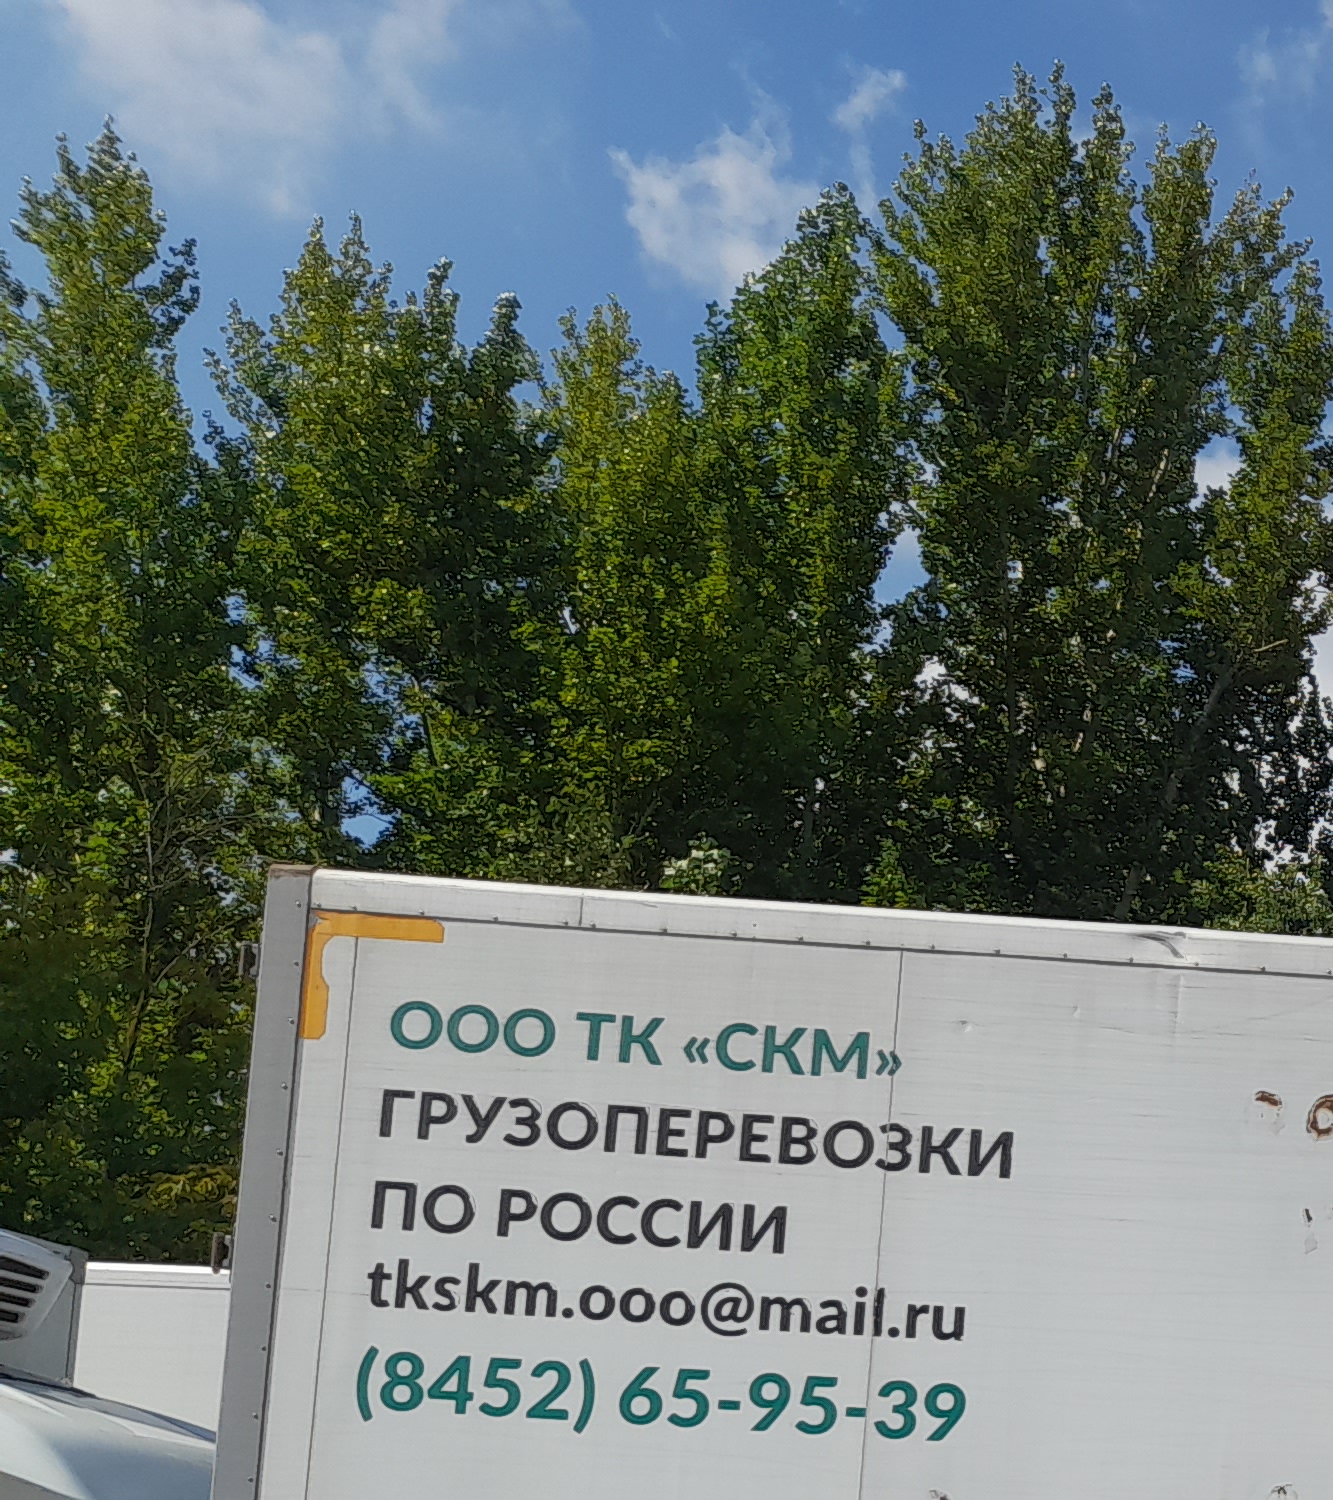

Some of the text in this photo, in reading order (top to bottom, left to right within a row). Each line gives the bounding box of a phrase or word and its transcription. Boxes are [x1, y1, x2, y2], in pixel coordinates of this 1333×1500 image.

[390, 1000, 902, 1080] ООО ТК «СКМ»
[379, 1088, 1014, 1179] ГРУЗОПЕРЕВОЗКИ
[370, 1180, 787, 1254] ПО РОССИИ
[367, 1258, 966, 1341] tkskm.ooo@mail.ru
[356, 1346, 966, 1442] (8452) 65-95-39
